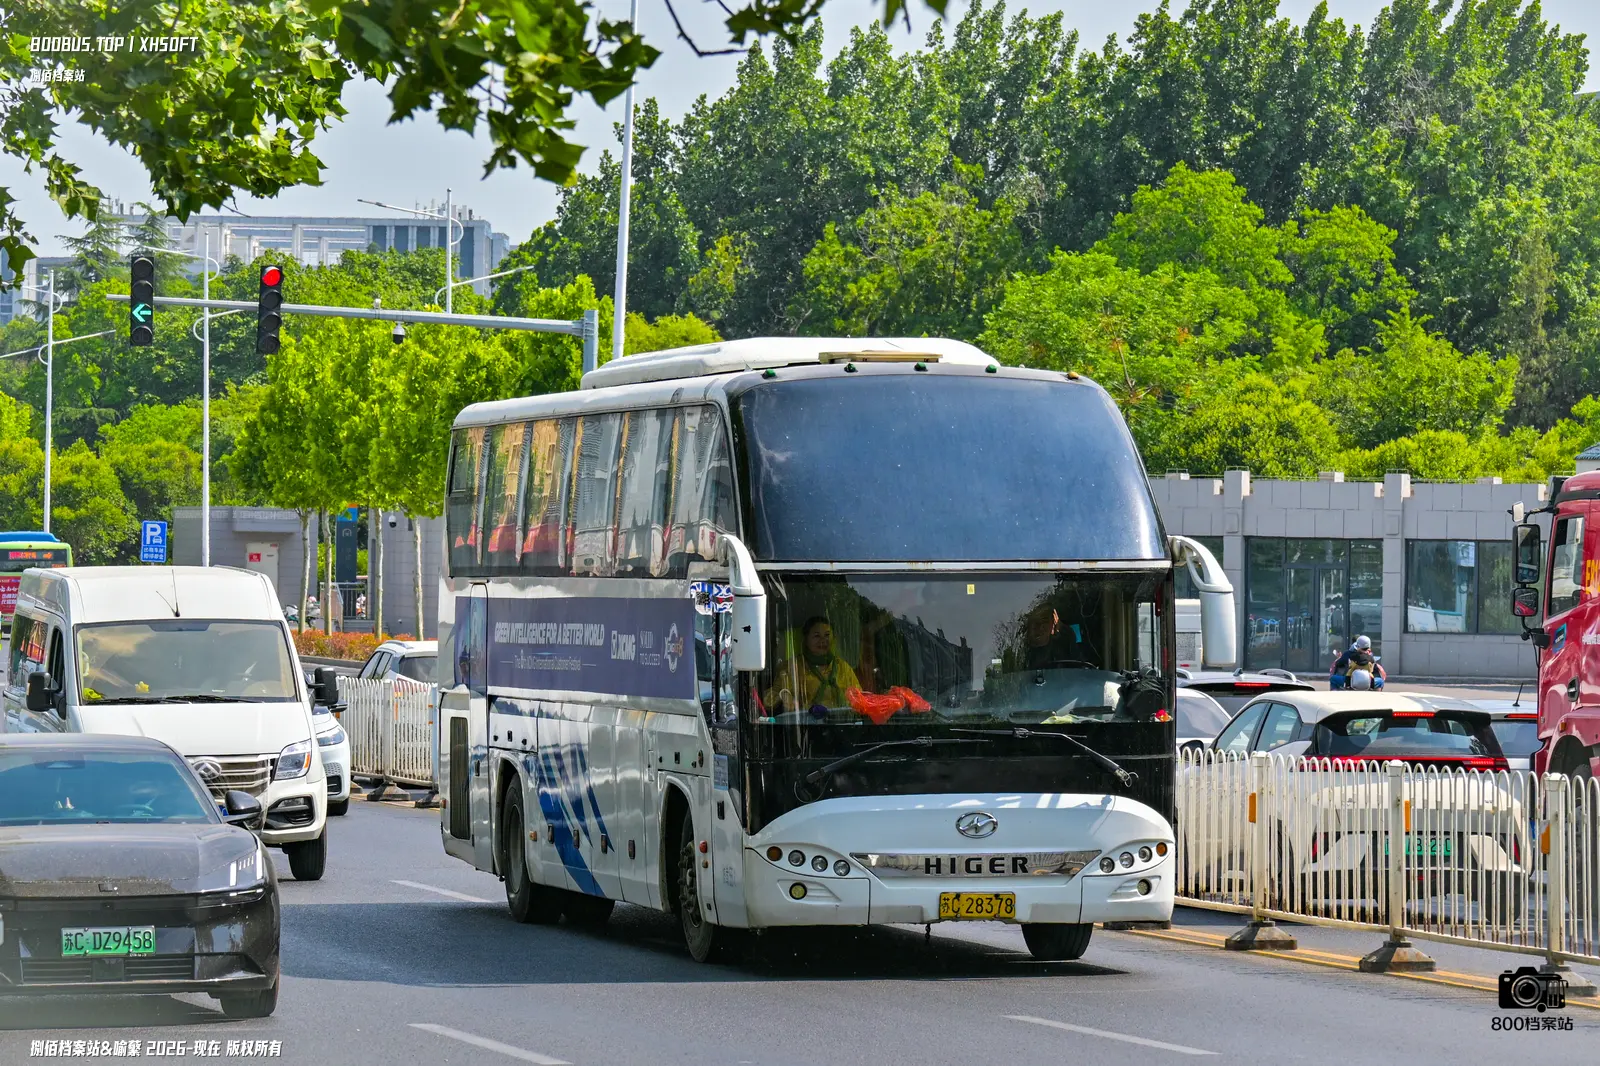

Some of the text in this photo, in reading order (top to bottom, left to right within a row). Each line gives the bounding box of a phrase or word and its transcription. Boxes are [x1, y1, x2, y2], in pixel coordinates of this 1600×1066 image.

[146, 523, 162, 544] P
[495, 622, 509, 643] GREEN
[510, 622, 546, 644] INTELLIGENCE
[546, 623, 557, 644] FOR
[562, 623, 583, 645] BETTER
[584, 624, 605, 646] WORLD
[924, 857, 1029, 875] HIGER
